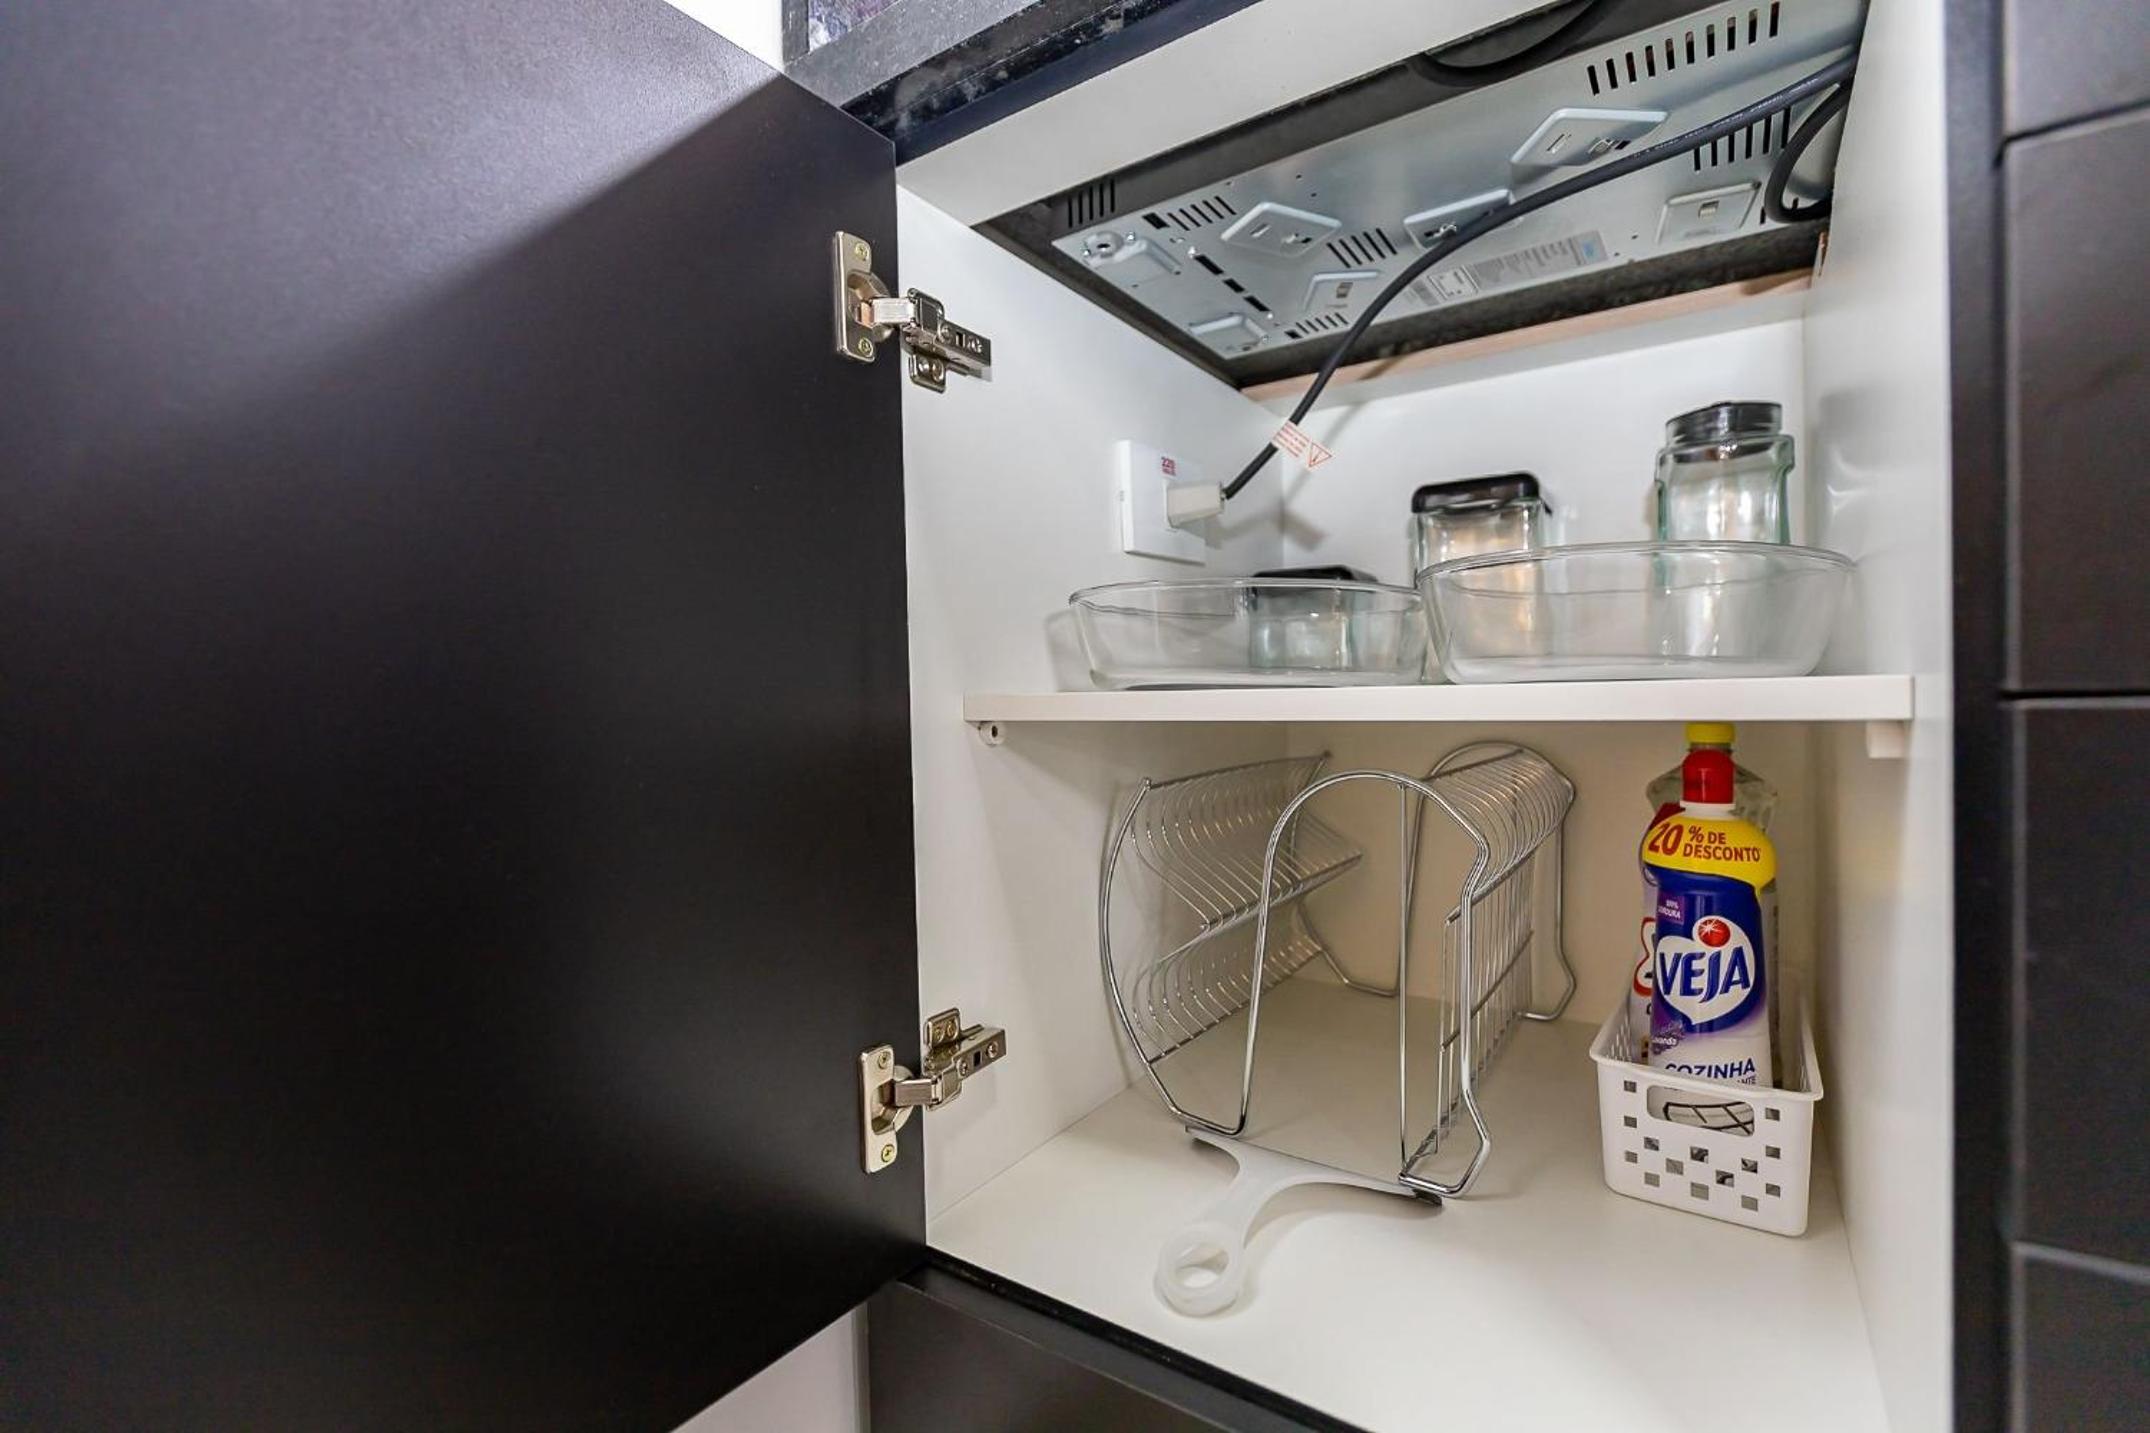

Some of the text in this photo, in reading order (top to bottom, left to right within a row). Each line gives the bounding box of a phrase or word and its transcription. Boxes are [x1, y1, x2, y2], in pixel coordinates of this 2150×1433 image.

[1708, 831, 1727, 844] DE
[1683, 843, 1761, 862] DESCONTO
[1660, 946, 1751, 1003] VEJA
